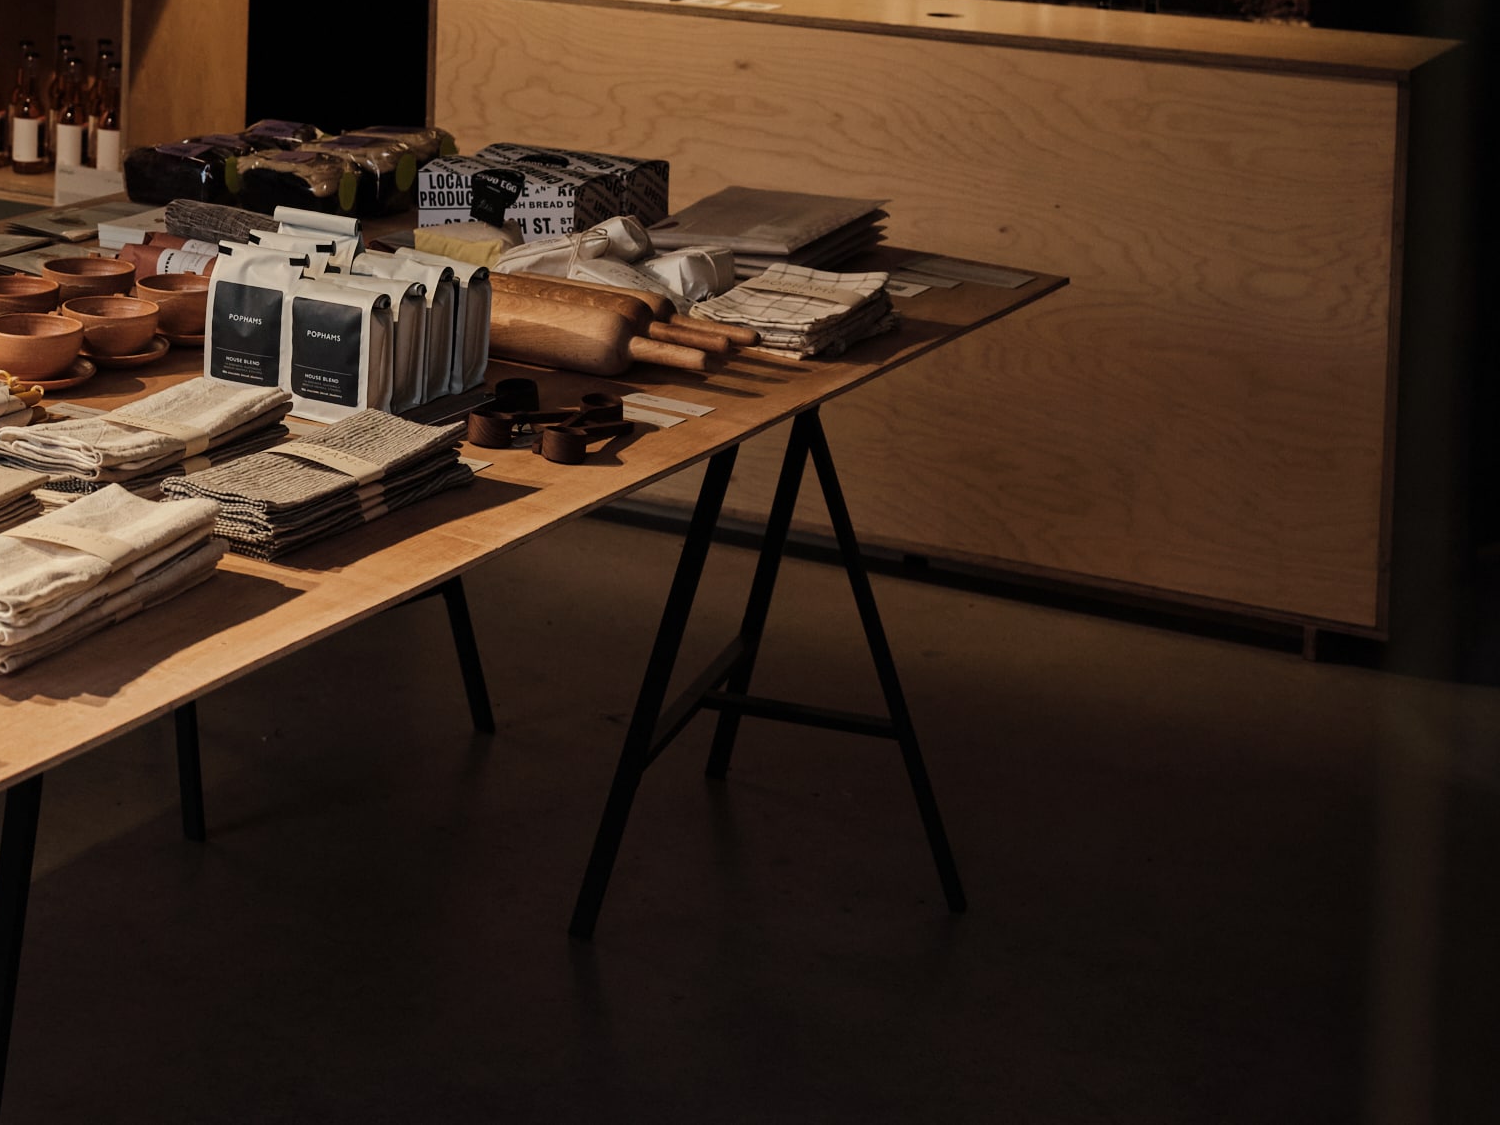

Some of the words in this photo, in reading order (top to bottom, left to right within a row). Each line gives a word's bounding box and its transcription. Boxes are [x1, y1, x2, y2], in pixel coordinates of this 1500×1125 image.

[429, 173, 471, 190] LOCAL
[420, 190, 474, 207] PRODUC
[529, 201, 564, 209] BREAD
[228, 313, 263, 326] POPHAMS
[306, 329, 341, 342] POPHAMS
[226, 356, 243, 364] HOUSE
[304, 373, 322, 381] HOUSE
[322, 376, 340, 384] BLEND
